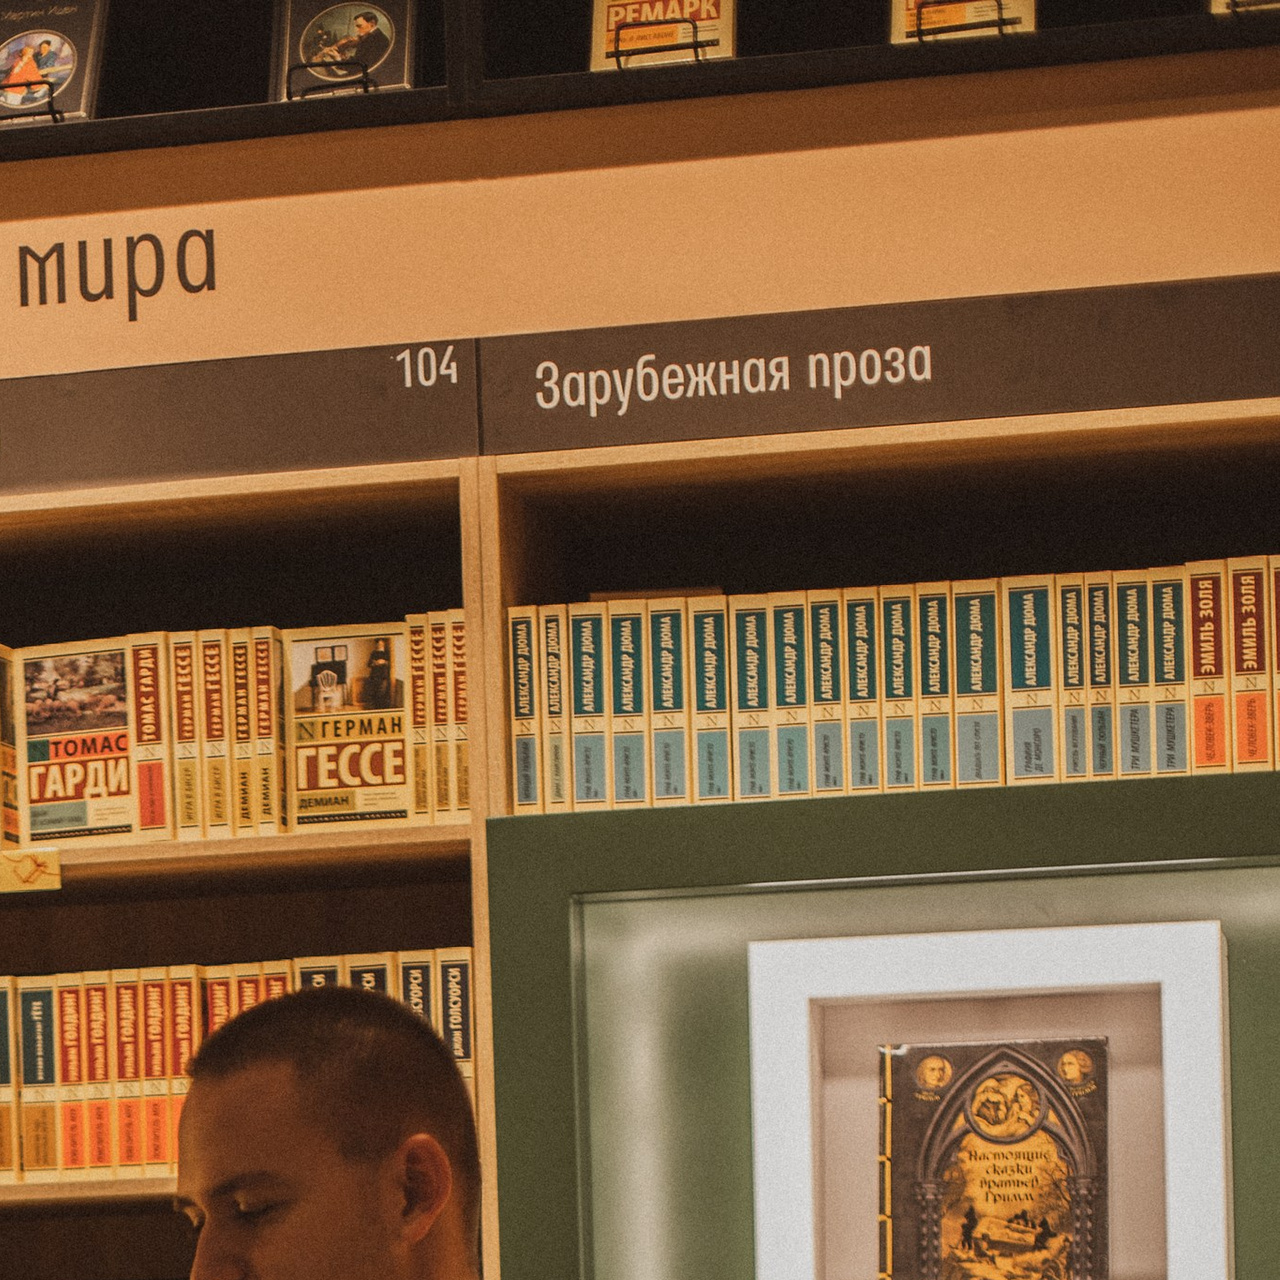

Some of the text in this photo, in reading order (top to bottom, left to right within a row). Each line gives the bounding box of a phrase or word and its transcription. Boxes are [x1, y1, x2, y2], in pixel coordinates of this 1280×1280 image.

[19, 228, 216, 323] мира
[395, 345, 458, 389] 104
[534, 343, 933, 417] Зарубежная проза
[1200, 580, 1217, 674] ЭМИЛЬ ЗОЛЯ
[1240, 575, 1258, 670] ЭМИЛЬ ЗОЛЯ
[205, 647, 221, 736] ГЕРМАН ГЕССЕ
[256, 643, 270, 734] ГЕРМАН ГЕССЕ
[516, 623, 530, 714] АЛЕКСАНДР ДЮМА
[546, 621, 560, 713] АЛЕКСАНДР ДЮМА
[581, 621, 595, 712] АЛЕКСАНДР ДЮМА
[620, 620, 634, 711] АЛЕКСАНДР ДЮМА
[660, 616, 674, 707] АЛЕКСАНДР ДЮМА
[703, 617, 717, 708] АЛЕКСАНДР ДЮМА
[745, 615, 759, 707] АЛЕКСАНДР ДЮМА
[782, 646, 796, 703] АЛЕКСАНДР
[819, 641, 833, 699] АЛЕКСАНДР
[138, 649, 156, 741] ТОМАС ГАРДИ
[176, 649, 193, 737] ГЕРМАН ГЕССЕ
[235, 648, 249, 738] ГЕРМАН ГЕССЕ
[52, 734, 128, 757] ТОМАС
[321, 716, 402, 738] ГЕРМАН
[1128, 708, 1141, 770] ТРИ МУШКЕТЕРА
[1163, 707, 1176, 768] ТРИ МУШКЕТЕРА
[28, 760, 130, 800] ГАРДИ
[239, 772, 250, 819] ДЕМИАН
[261, 768, 272, 815] ДЕМИАН
[297, 741, 405, 790] ГЕССЕ
[62, 991, 77, 1046] ГОЛДИНГ
[90, 989, 104, 1044] ГОЛДИНГ
[119, 987, 134, 1042] ГОЛДИНГ
[147, 985, 162, 1040] ГОЛДИНГ
[174, 983, 189, 1038] ГОЛДИНГ
[448, 967, 462, 1029] ГОЛСУОРСИ
